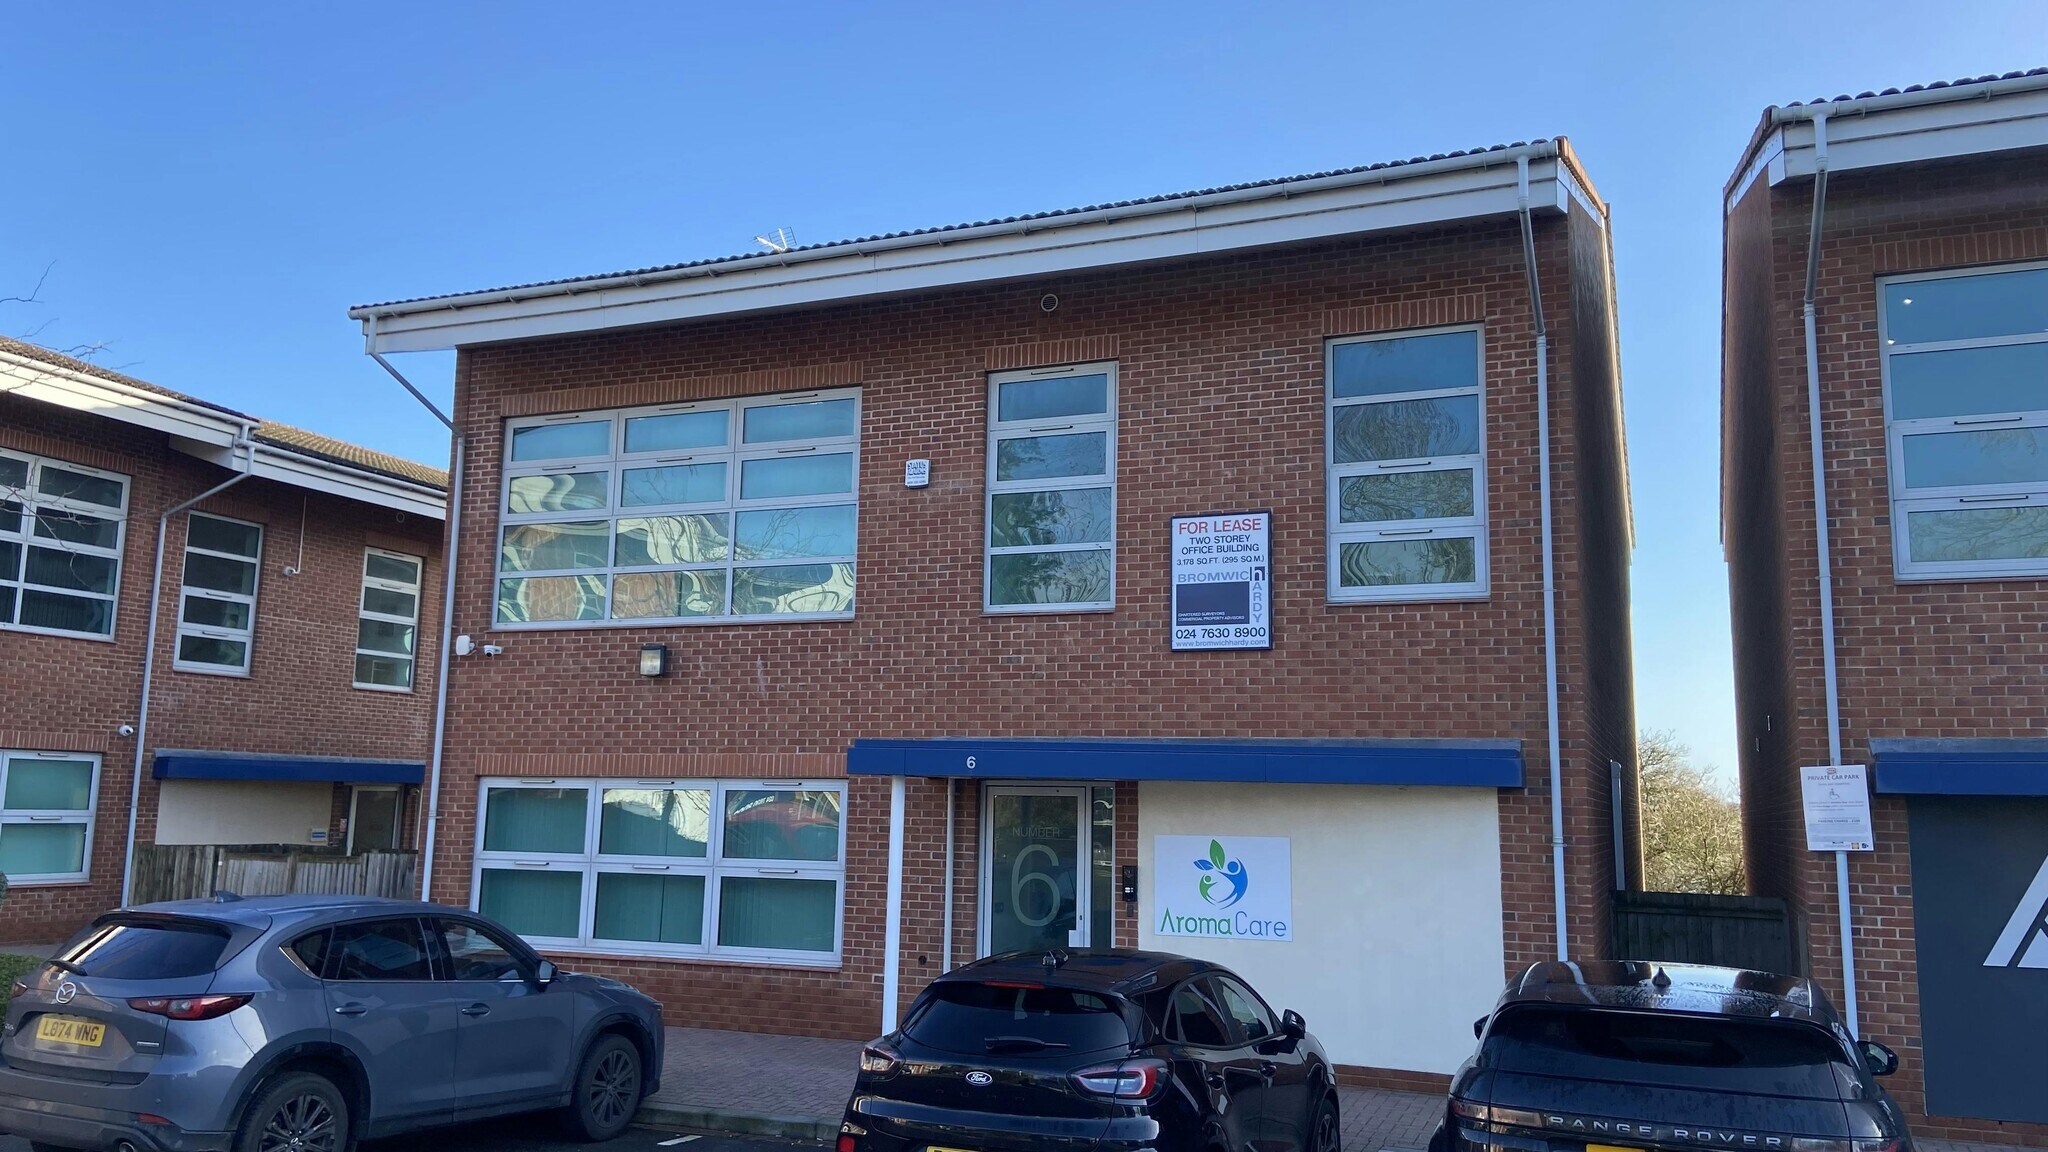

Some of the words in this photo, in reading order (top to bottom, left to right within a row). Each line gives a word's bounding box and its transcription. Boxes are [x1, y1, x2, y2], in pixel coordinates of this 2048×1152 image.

[1179, 521, 1208, 535] FOR
[1213, 518, 1262, 533] LEASE
[1189, 536, 1211, 545] TWO
[1214, 534, 1251, 544] STOREY
[1181, 545, 1214, 556] OFFICE
[1216, 543, 1260, 554] BUILDING
[1176, 558, 1195, 567] 3,178
[1221, 556, 1239, 565] (295
[1176, 629, 1197, 639] 024
[1201, 628, 1230, 639] 7630
[1234, 627, 1266, 638] 8900
[1176, 639, 1266, 647] www.bromwichhardy.com
[966, 755, 976, 769] 6
[1012, 826, 1060, 838] NUMBER
[1011, 844, 1060, 927] 6
[74, 1023, 99, 1042] WNG
[1549, 1116, 1652, 1134] RANGE
[1674, 1129, 1782, 1147] ROVER
